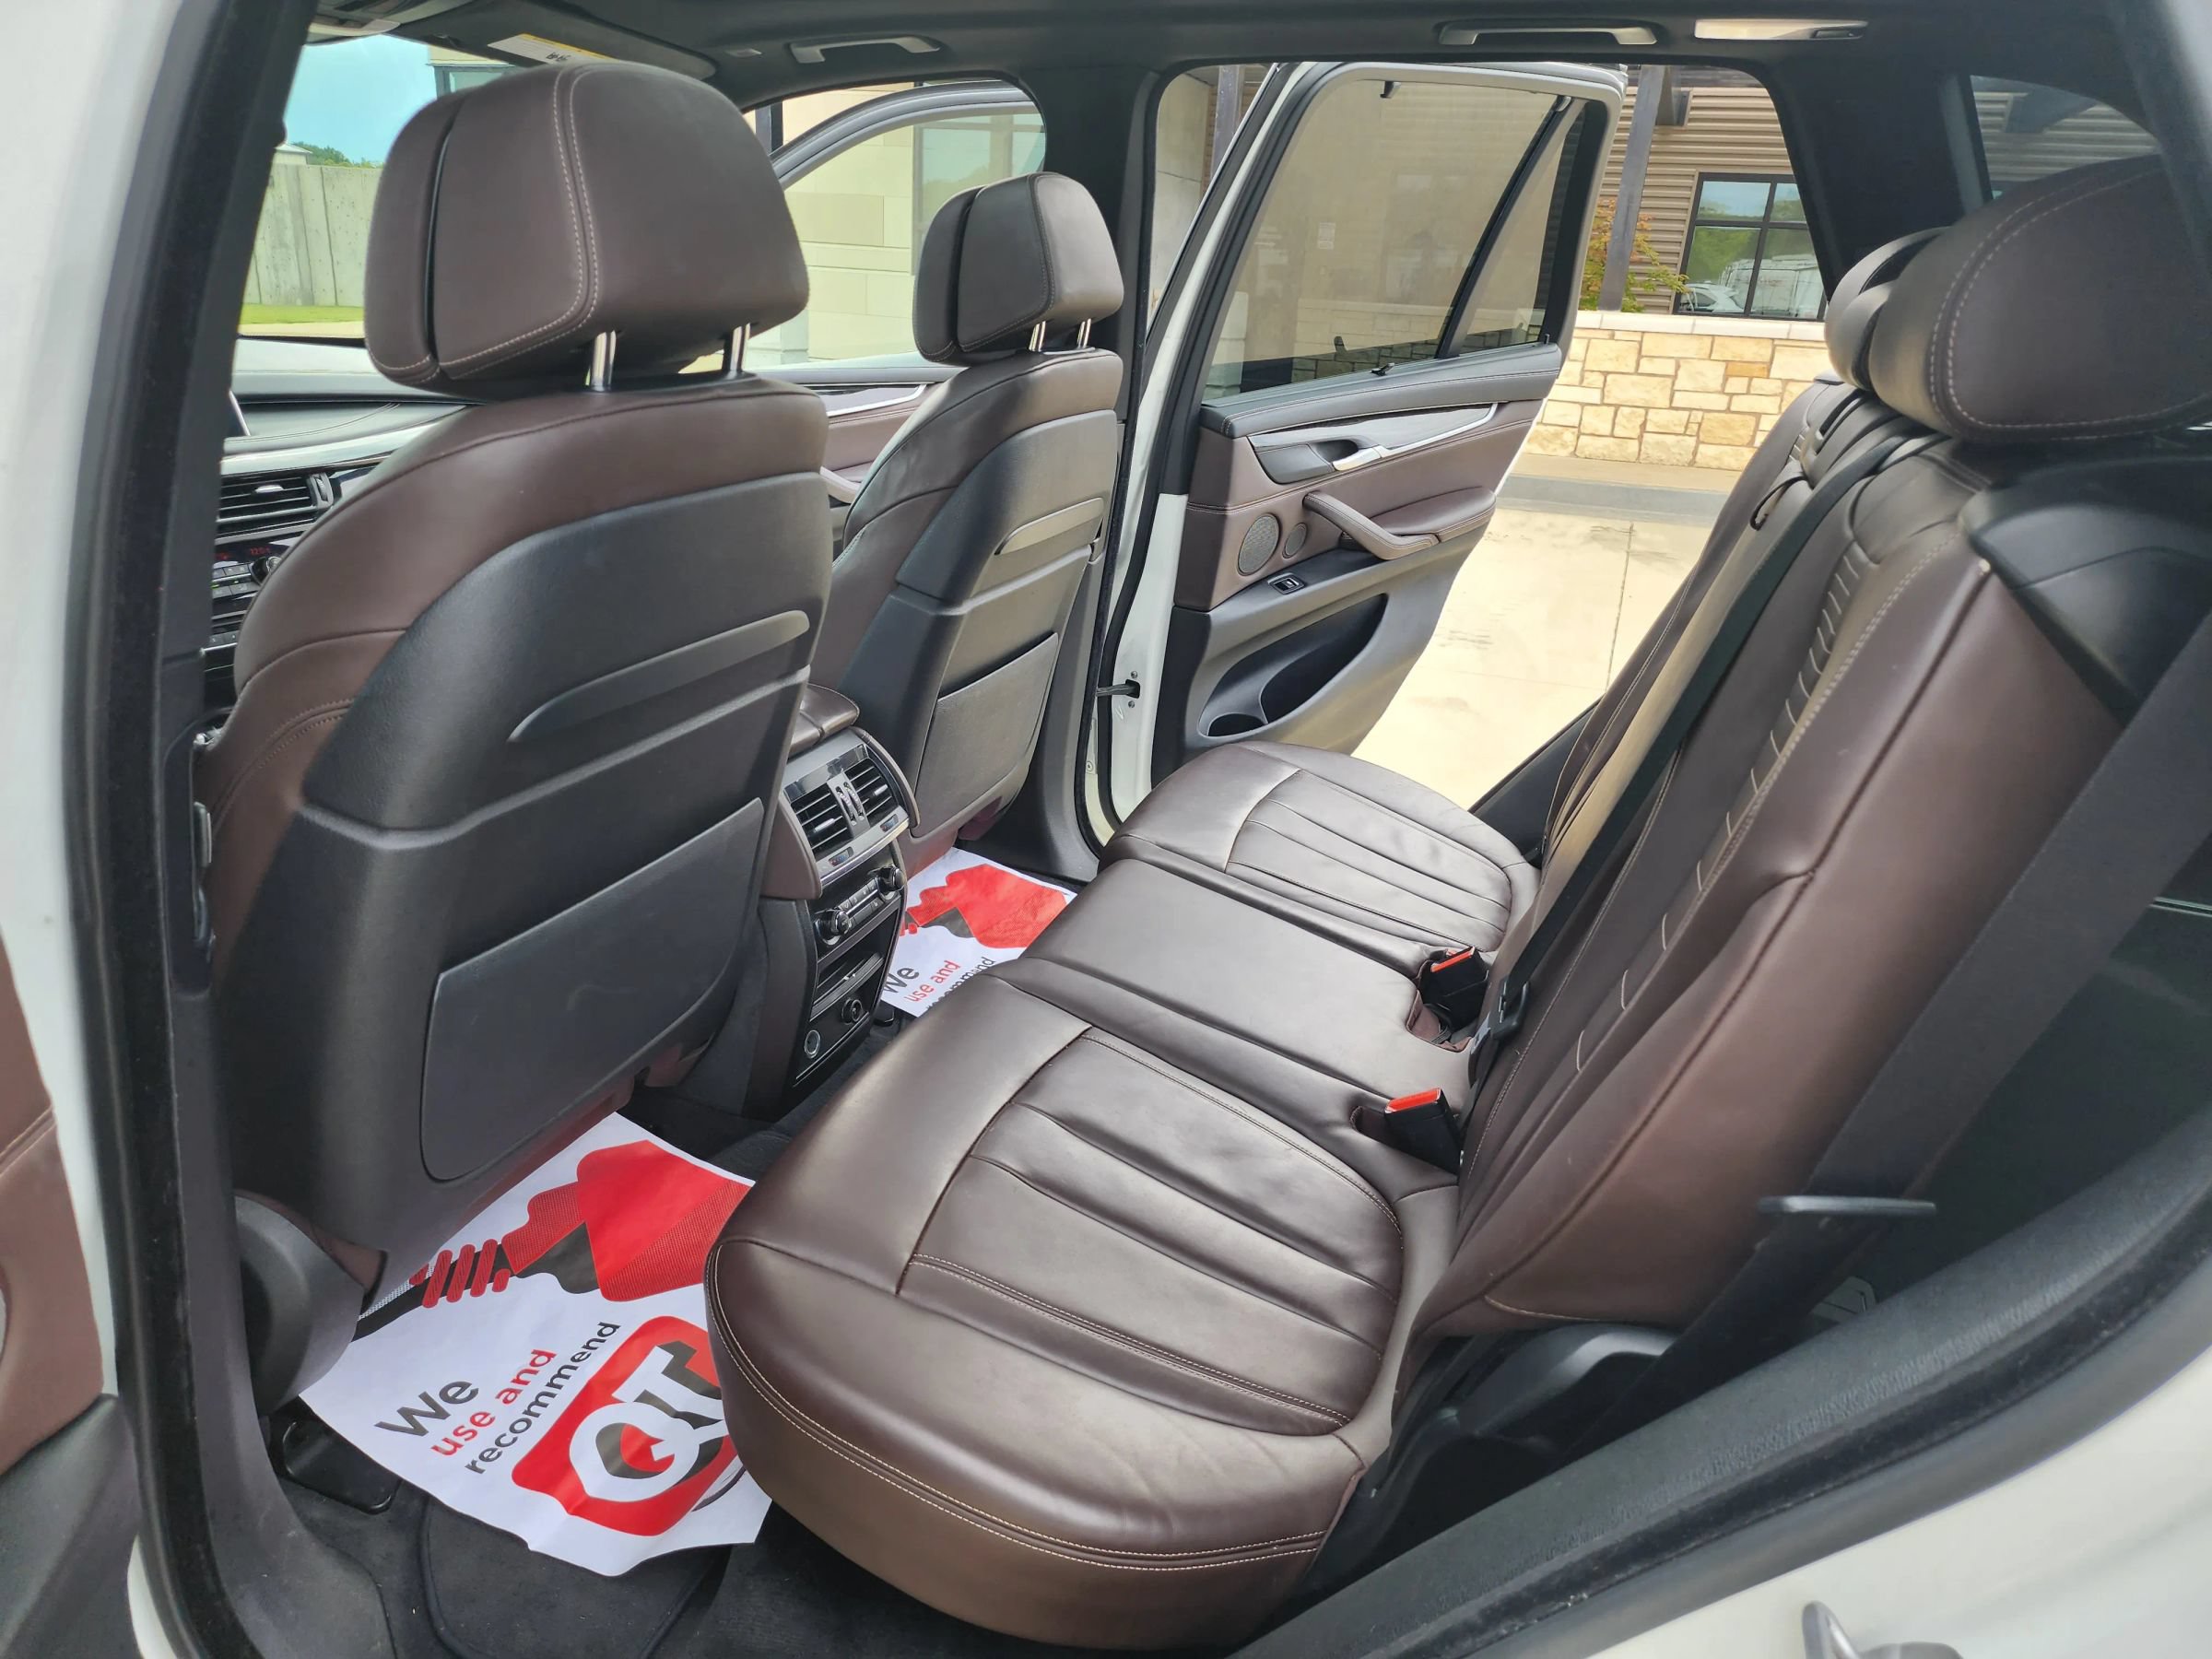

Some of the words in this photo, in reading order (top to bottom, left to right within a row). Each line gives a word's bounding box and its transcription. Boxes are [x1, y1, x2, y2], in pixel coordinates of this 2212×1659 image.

[883, 967, 920, 994] We
[904, 983, 935, 1003] use
[930, 960, 960, 983] and
[926, 957, 995, 1009] mmend
[375, 1381, 479, 1438] We
[430, 1411, 497, 1456] use
[494, 1348, 558, 1405] and
[465, 1322, 621, 1474] recommend
[570, 1346, 735, 1502] QT
